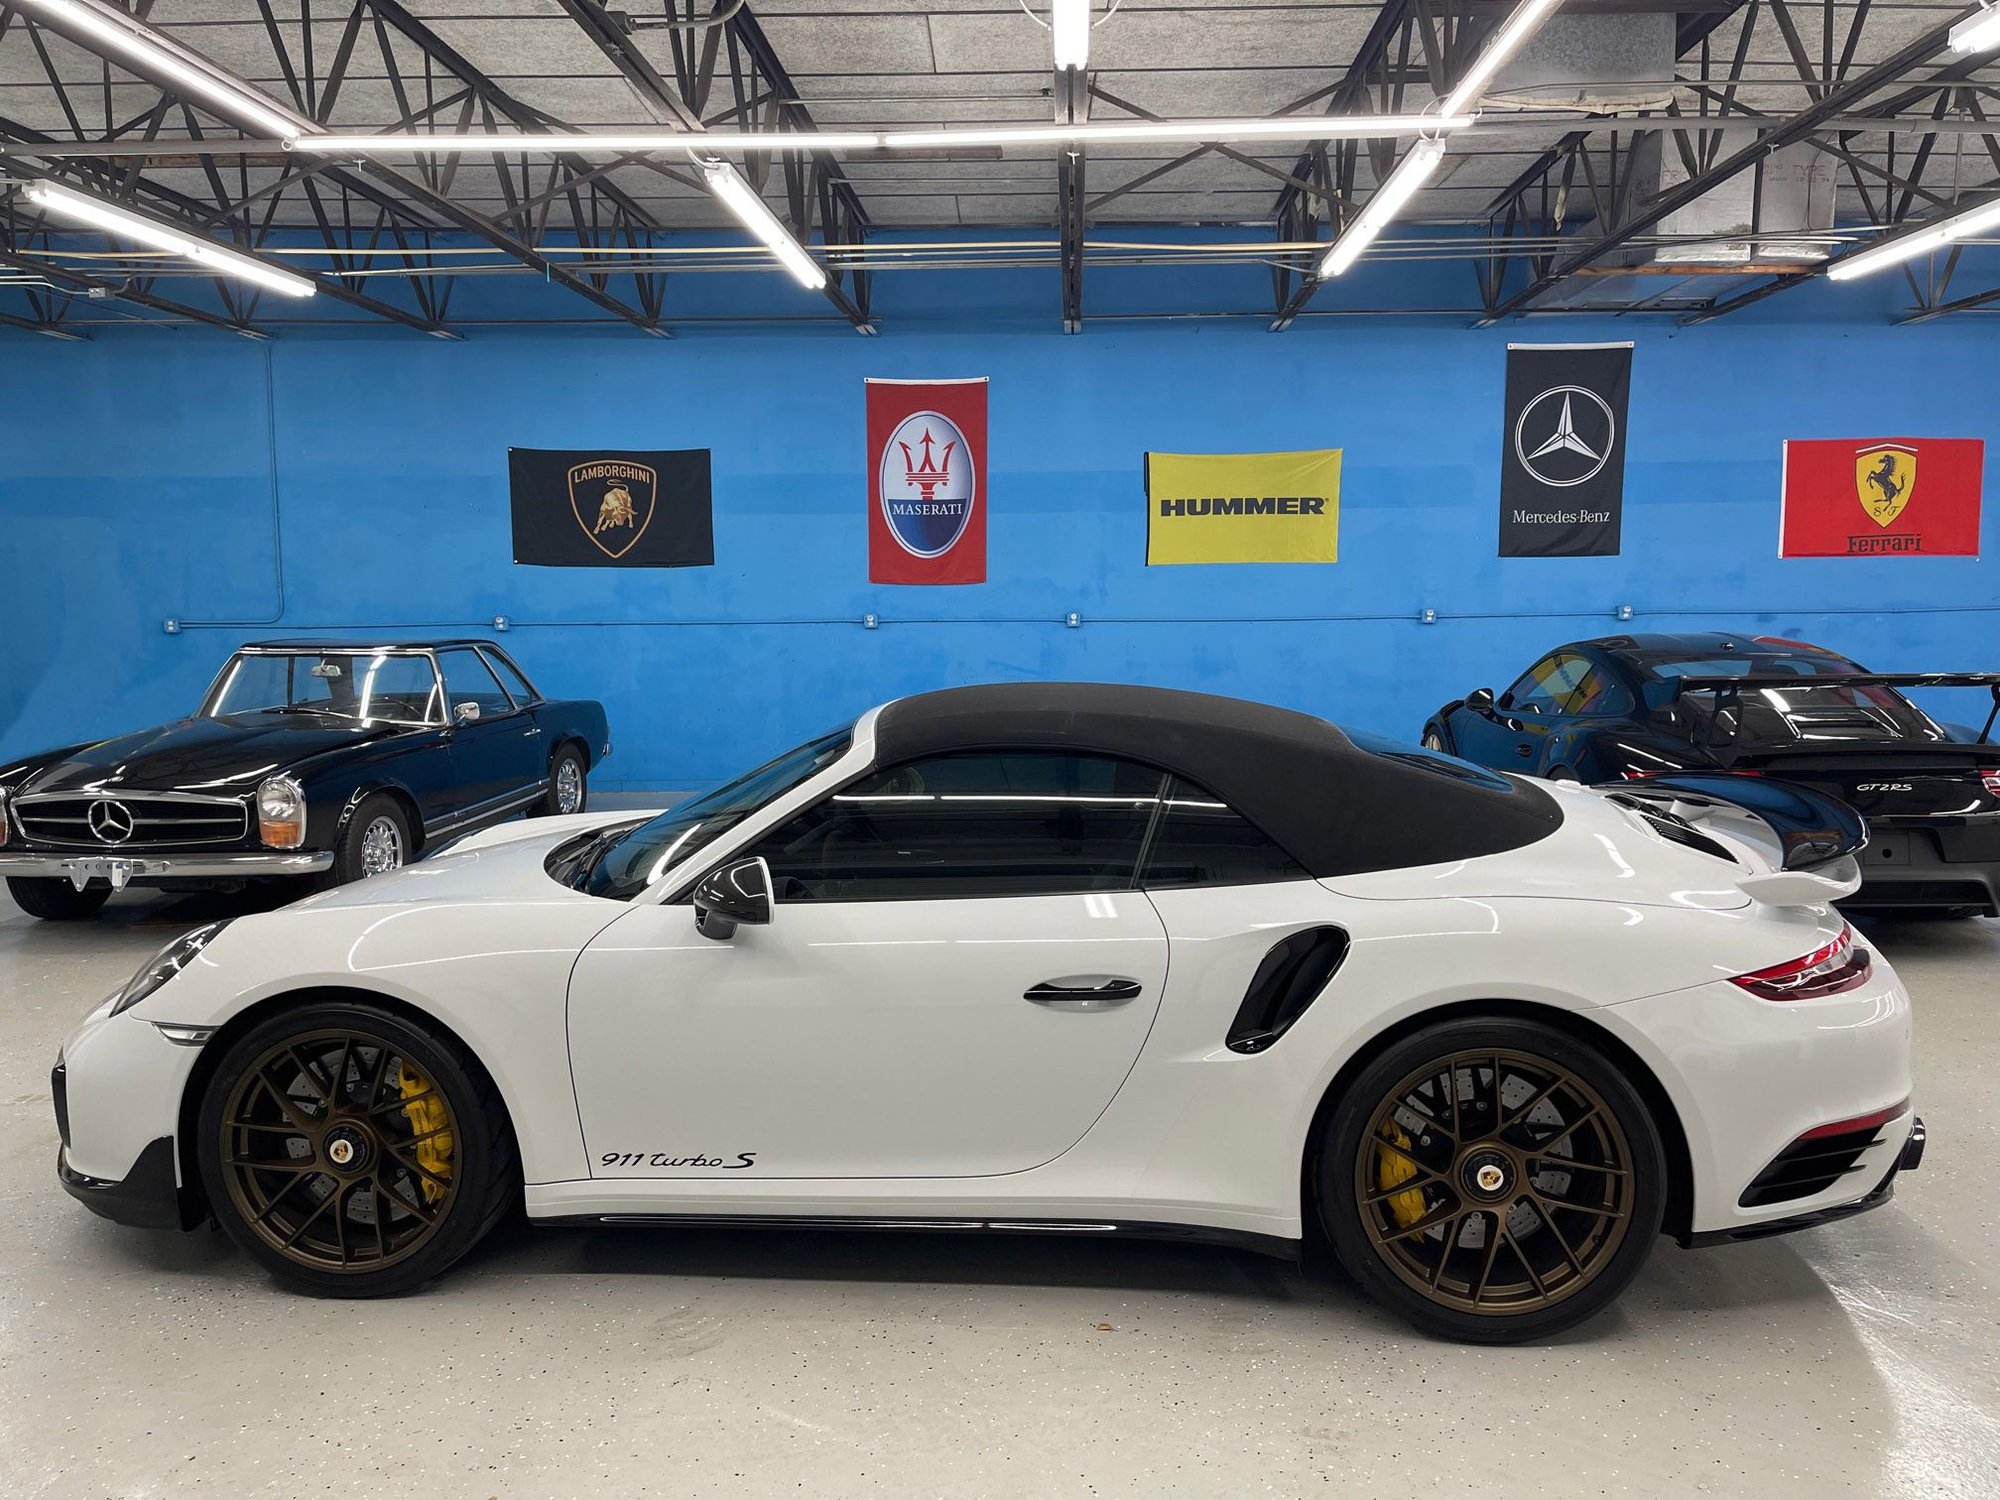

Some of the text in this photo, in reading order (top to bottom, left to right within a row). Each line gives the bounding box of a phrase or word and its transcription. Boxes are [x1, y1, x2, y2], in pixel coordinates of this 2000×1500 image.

[574, 465, 650, 484] LAMBORGHINI
[892, 503, 962, 516] MASERATI
[1161, 497, 1325, 517] HUMMER
[1512, 509, 1610, 524] Mercedes-Benz
[1847, 533, 1921, 553] Ferrari
[601, 1152, 757, 1169] 911 turbo S
